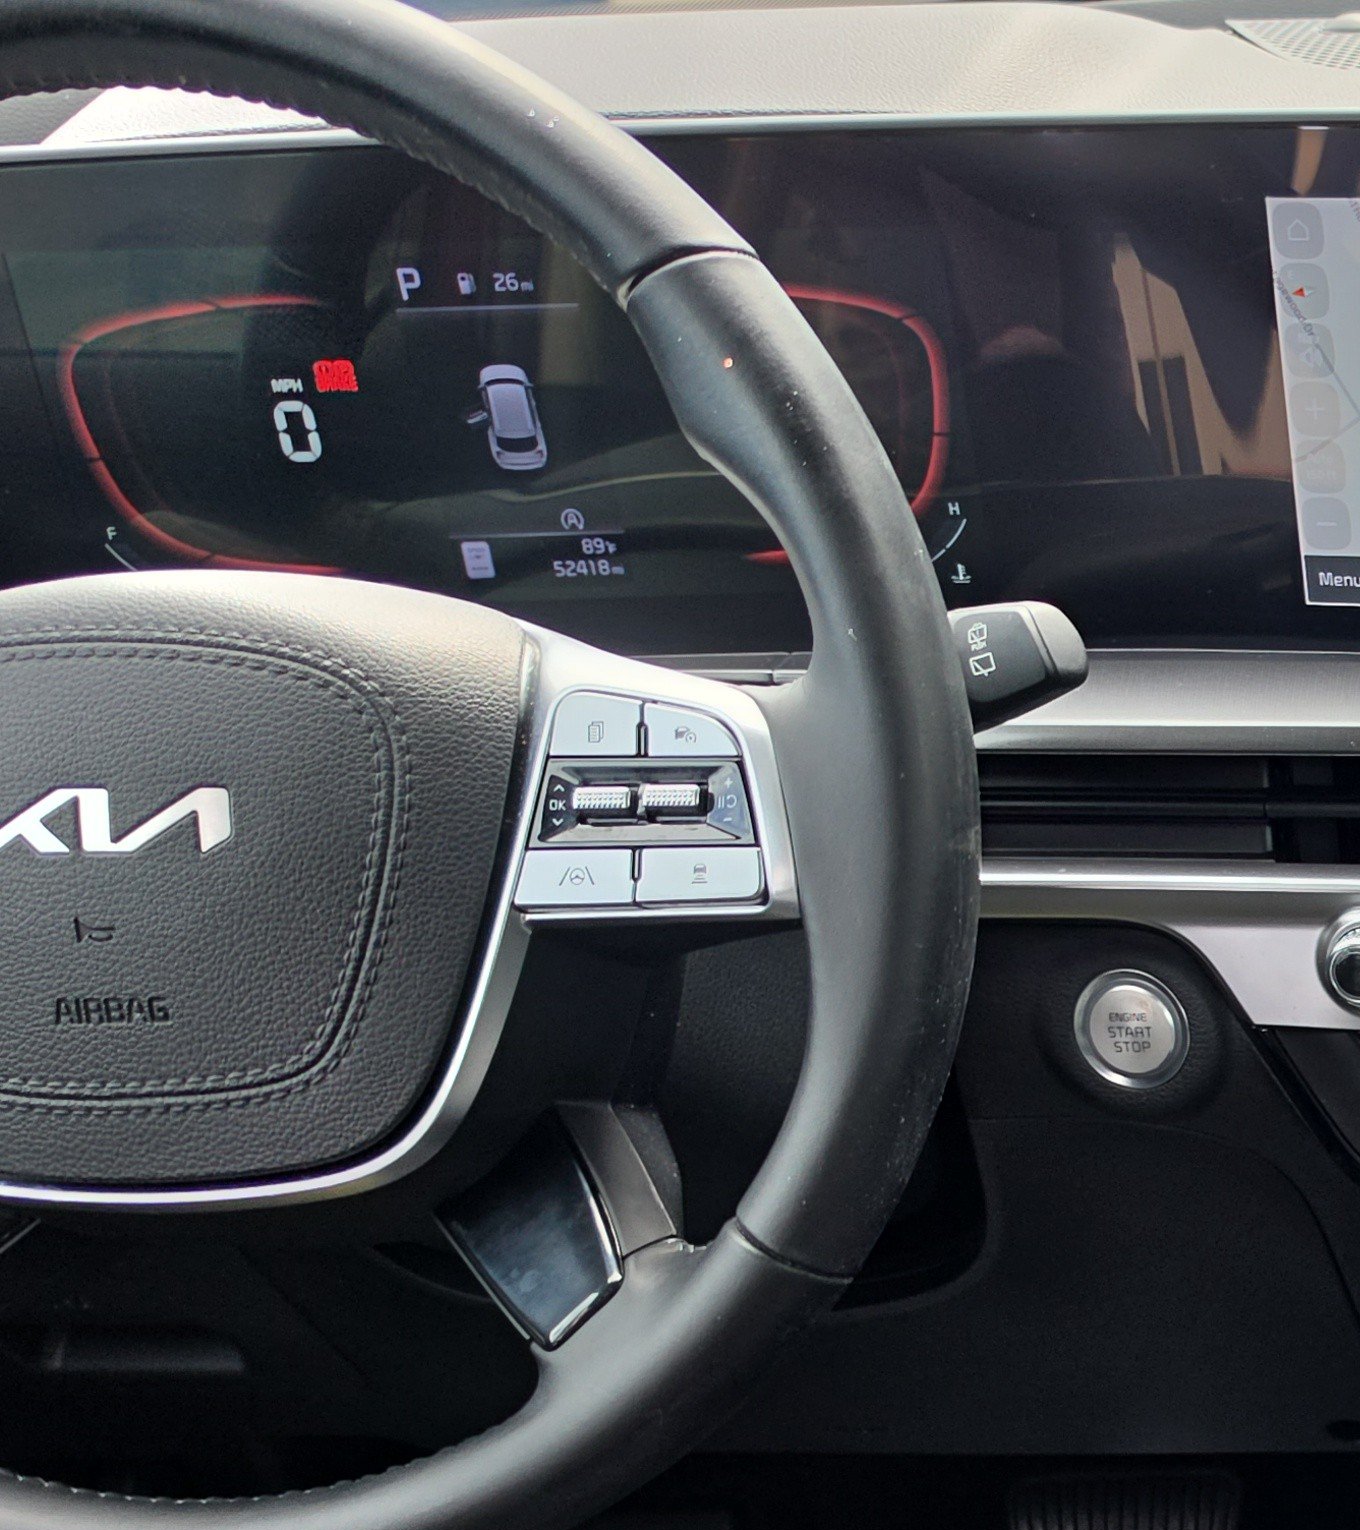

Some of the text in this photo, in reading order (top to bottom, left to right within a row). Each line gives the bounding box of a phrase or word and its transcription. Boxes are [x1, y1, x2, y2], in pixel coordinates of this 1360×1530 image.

[396, 267, 421, 301] P
[270, 378, 303, 393] MPH
[273, 400, 322, 463] 0
[948, 502, 961, 516] H
[106, 527, 118, 541] F
[549, 799, 566, 811] OK
[55, 998, 171, 1025] AIRBAG
[1107, 1026, 1152, 1038] START
[1113, 1041, 1151, 1053] STOP
